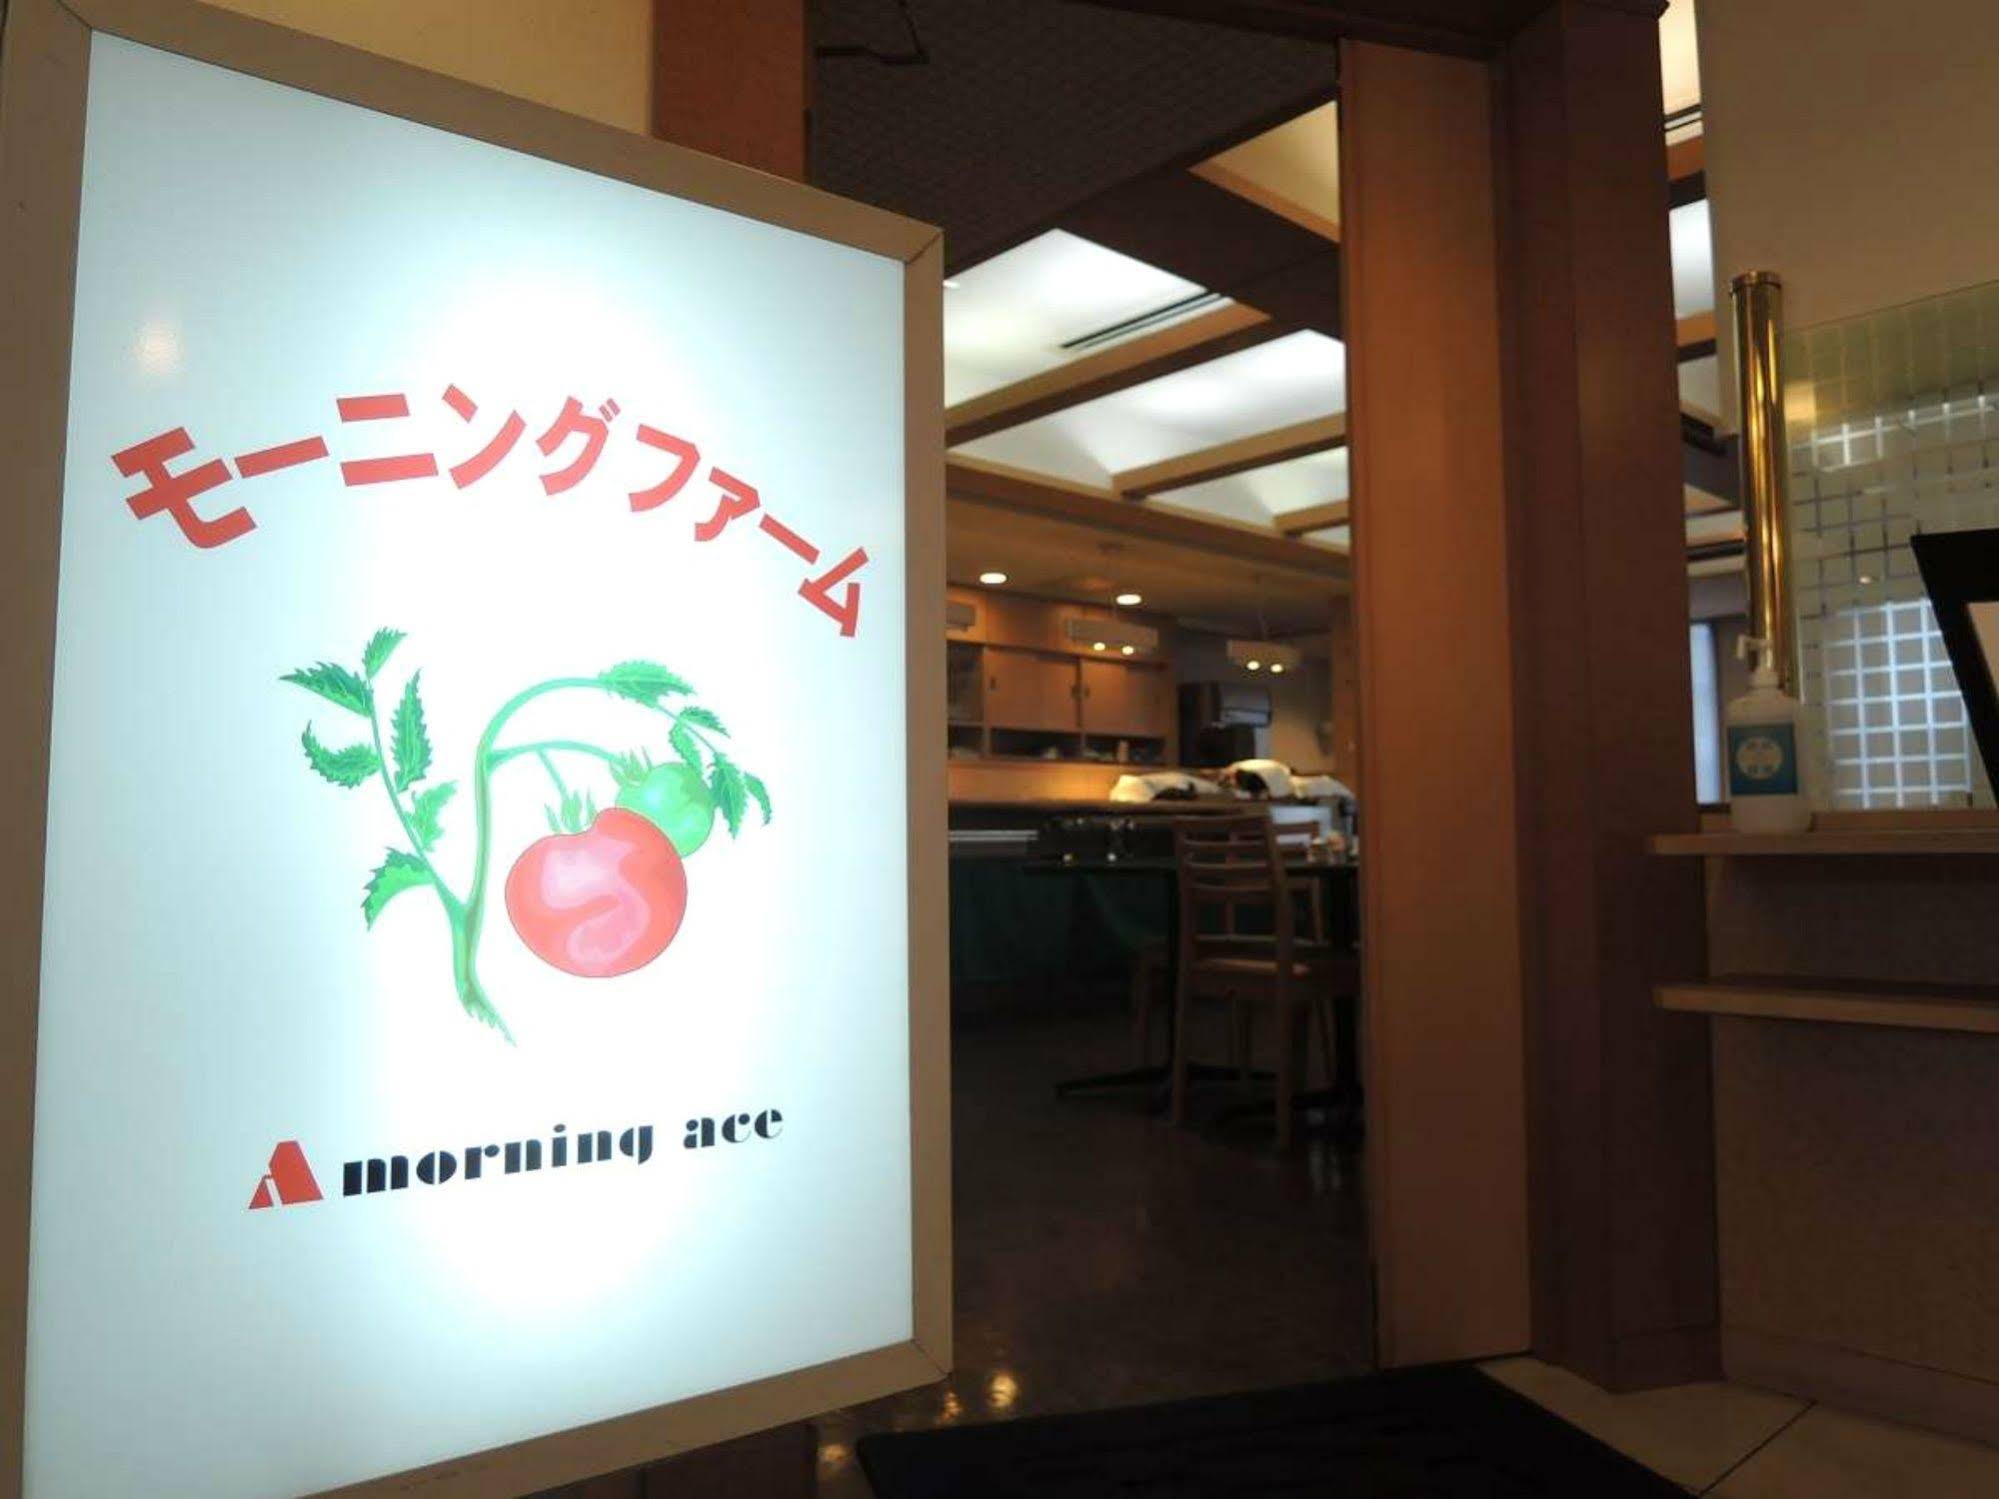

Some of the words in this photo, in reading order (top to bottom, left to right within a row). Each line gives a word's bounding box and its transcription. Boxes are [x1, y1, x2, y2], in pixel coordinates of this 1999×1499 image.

[111, 384, 868, 637] モーニングファーム
[343, 1123, 653, 1197] morning
[683, 1108, 783, 1149] ace
